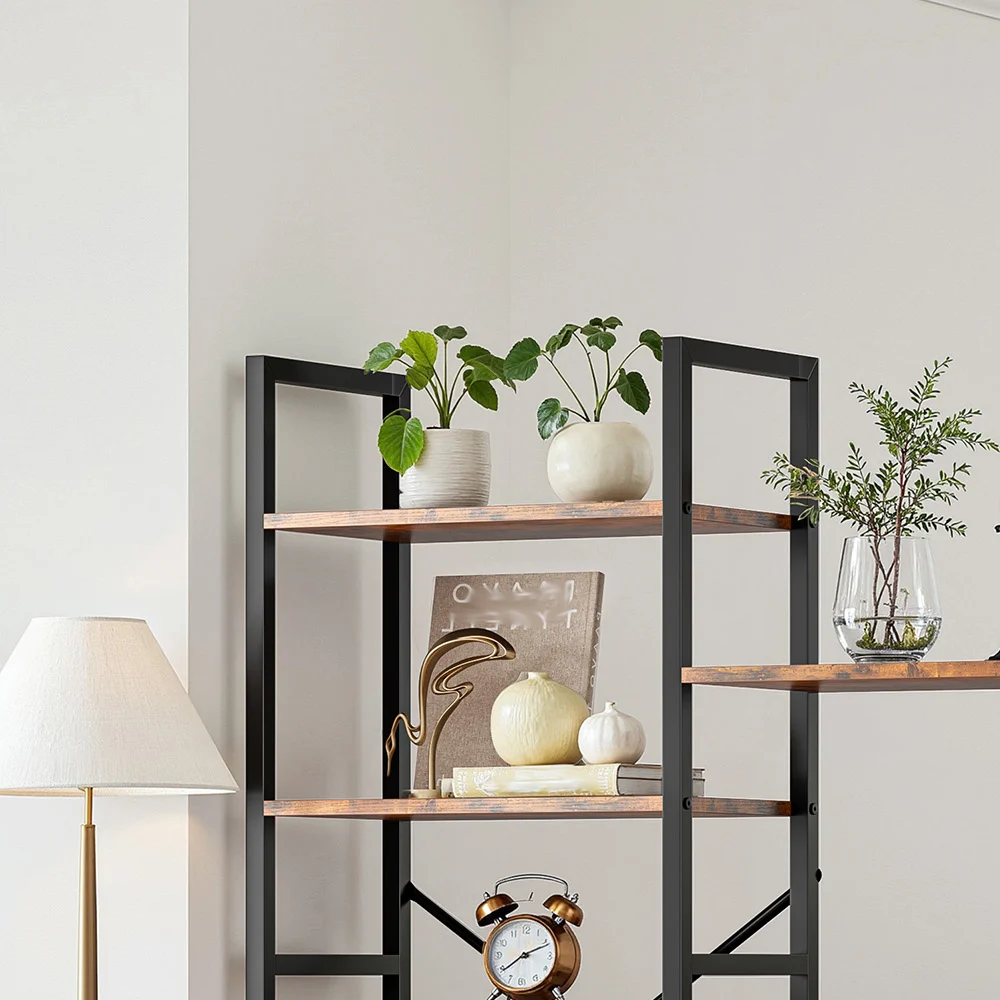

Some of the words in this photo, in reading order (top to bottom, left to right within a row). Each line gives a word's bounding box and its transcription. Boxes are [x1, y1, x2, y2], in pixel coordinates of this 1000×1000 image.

[510, 930, 517, 938] 11
[522, 924, 531, 935] 12
[507, 974, 513, 984] 7
